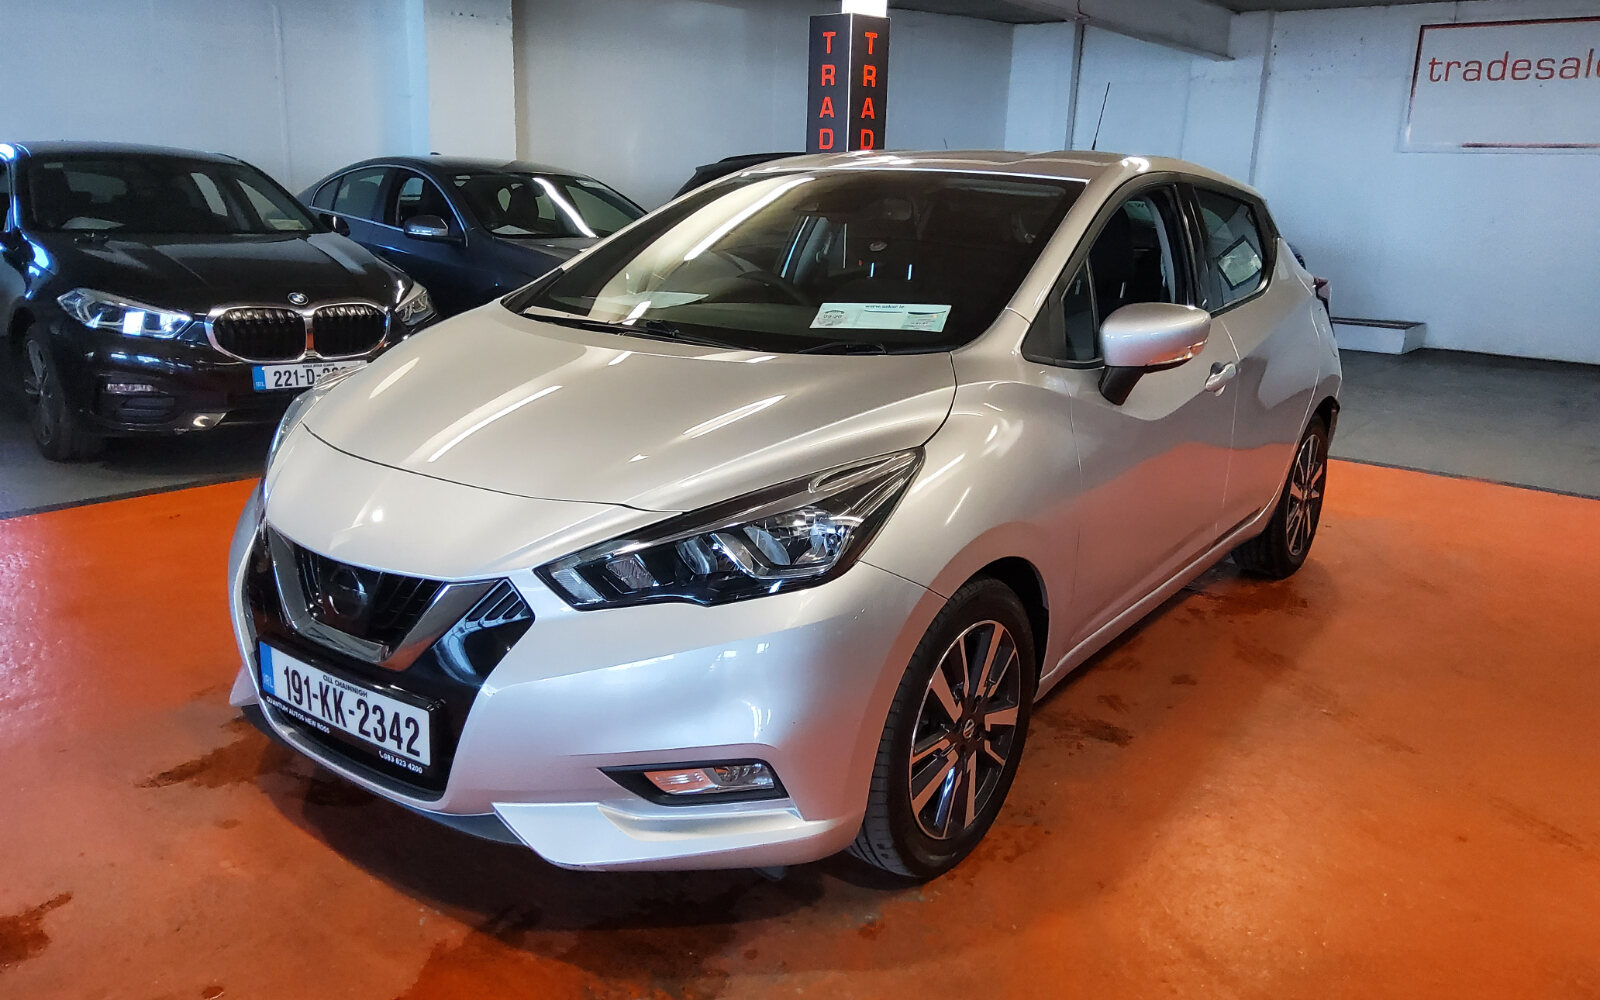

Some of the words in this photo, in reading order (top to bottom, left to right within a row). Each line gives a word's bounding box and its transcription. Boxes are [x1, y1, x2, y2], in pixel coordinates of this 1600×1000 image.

[819, 31, 836, 150] TRAD
[860, 31, 878, 150] TRAD
[1428, 48, 1600, 83] tradesal
[273, 367, 346, 388] 221-D-
[283, 665, 421, 758] 191-KK-2342
[289, 708, 305, 721] AUTOS
